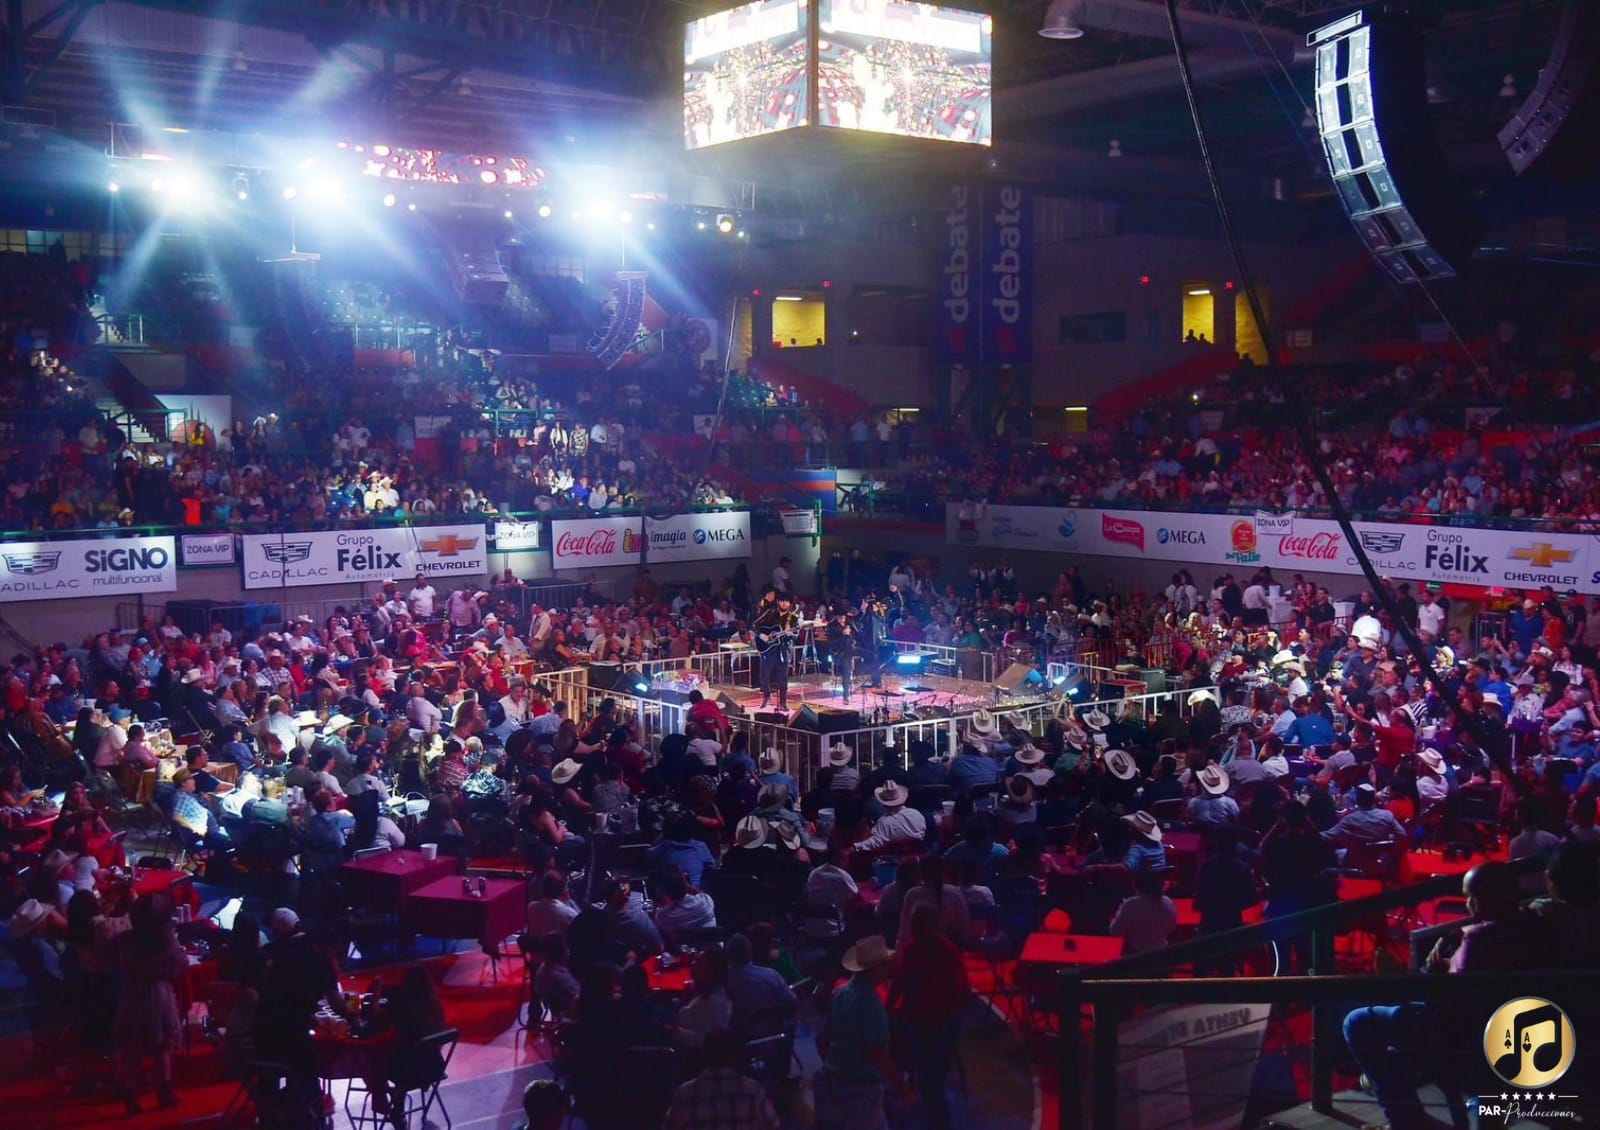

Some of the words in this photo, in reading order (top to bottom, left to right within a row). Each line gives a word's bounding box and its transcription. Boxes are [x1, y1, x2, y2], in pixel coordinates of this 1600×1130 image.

[944, 184, 969, 323] debate
[993, 186, 1020, 323] debate
[1257, 518, 1275, 527] ZONA
[1277, 518, 1290, 527] VIP
[336, 534, 374, 547] Grupo
[708, 528, 745, 541] MEGA
[1170, 529, 1206, 544] MEGA
[1427, 529, 1463, 544] Grupo
[186, 545, 213, 554] ZONA
[214, 544, 230, 553] VIP
[556, 529, 618, 557] Coca-Cola
[1278, 532, 1342, 560] Coca-Cola
[84, 547, 168, 572] SiGNO
[337, 545, 402, 571] Félix
[1346, 557, 1417, 570] CDILLAC
[1425, 544, 1489, 573] Félix
[416, 560, 481, 572] CHEVROLET
[0, 579, 80, 592] ADILLAC
[1504, 572, 1578, 584] CHEVROLET
